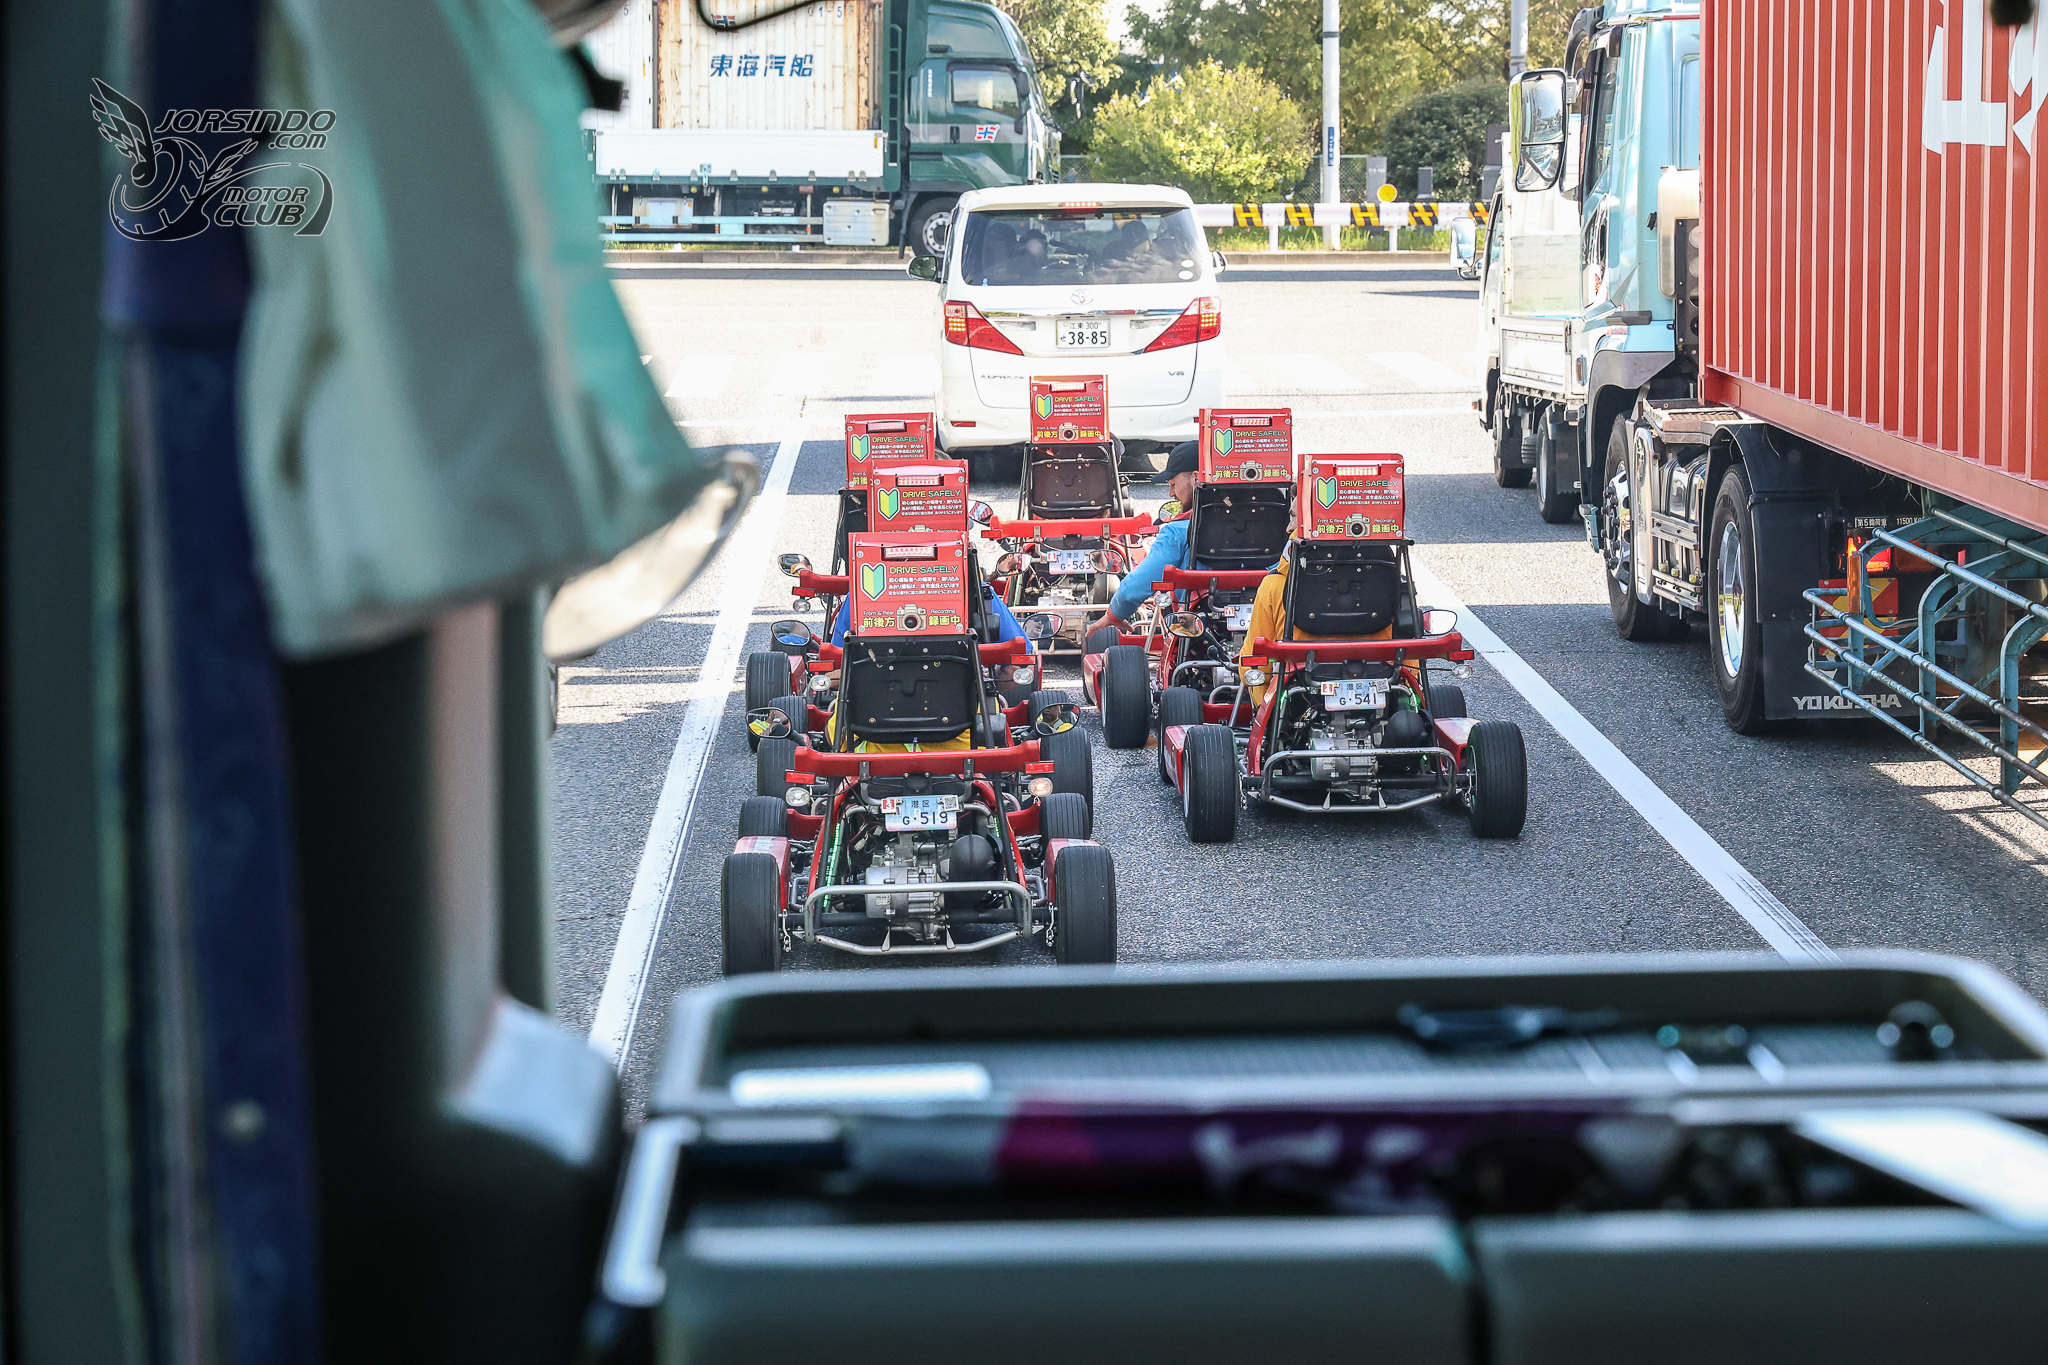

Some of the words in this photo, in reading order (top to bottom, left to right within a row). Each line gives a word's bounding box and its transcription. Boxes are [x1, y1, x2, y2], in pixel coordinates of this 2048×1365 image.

[709, 53, 815, 78] 東海汽船
[1068, 331, 1107, 345] 38-85
[1365, 479, 1399, 487] SAFELY
[1316, 524, 1344, 534] 前後方
[889, 566, 918, 574] DRIVE
[919, 565, 959, 574] SAFELY
[863, 616, 896, 628] 前後方
[928, 615, 961, 626] 録画中
